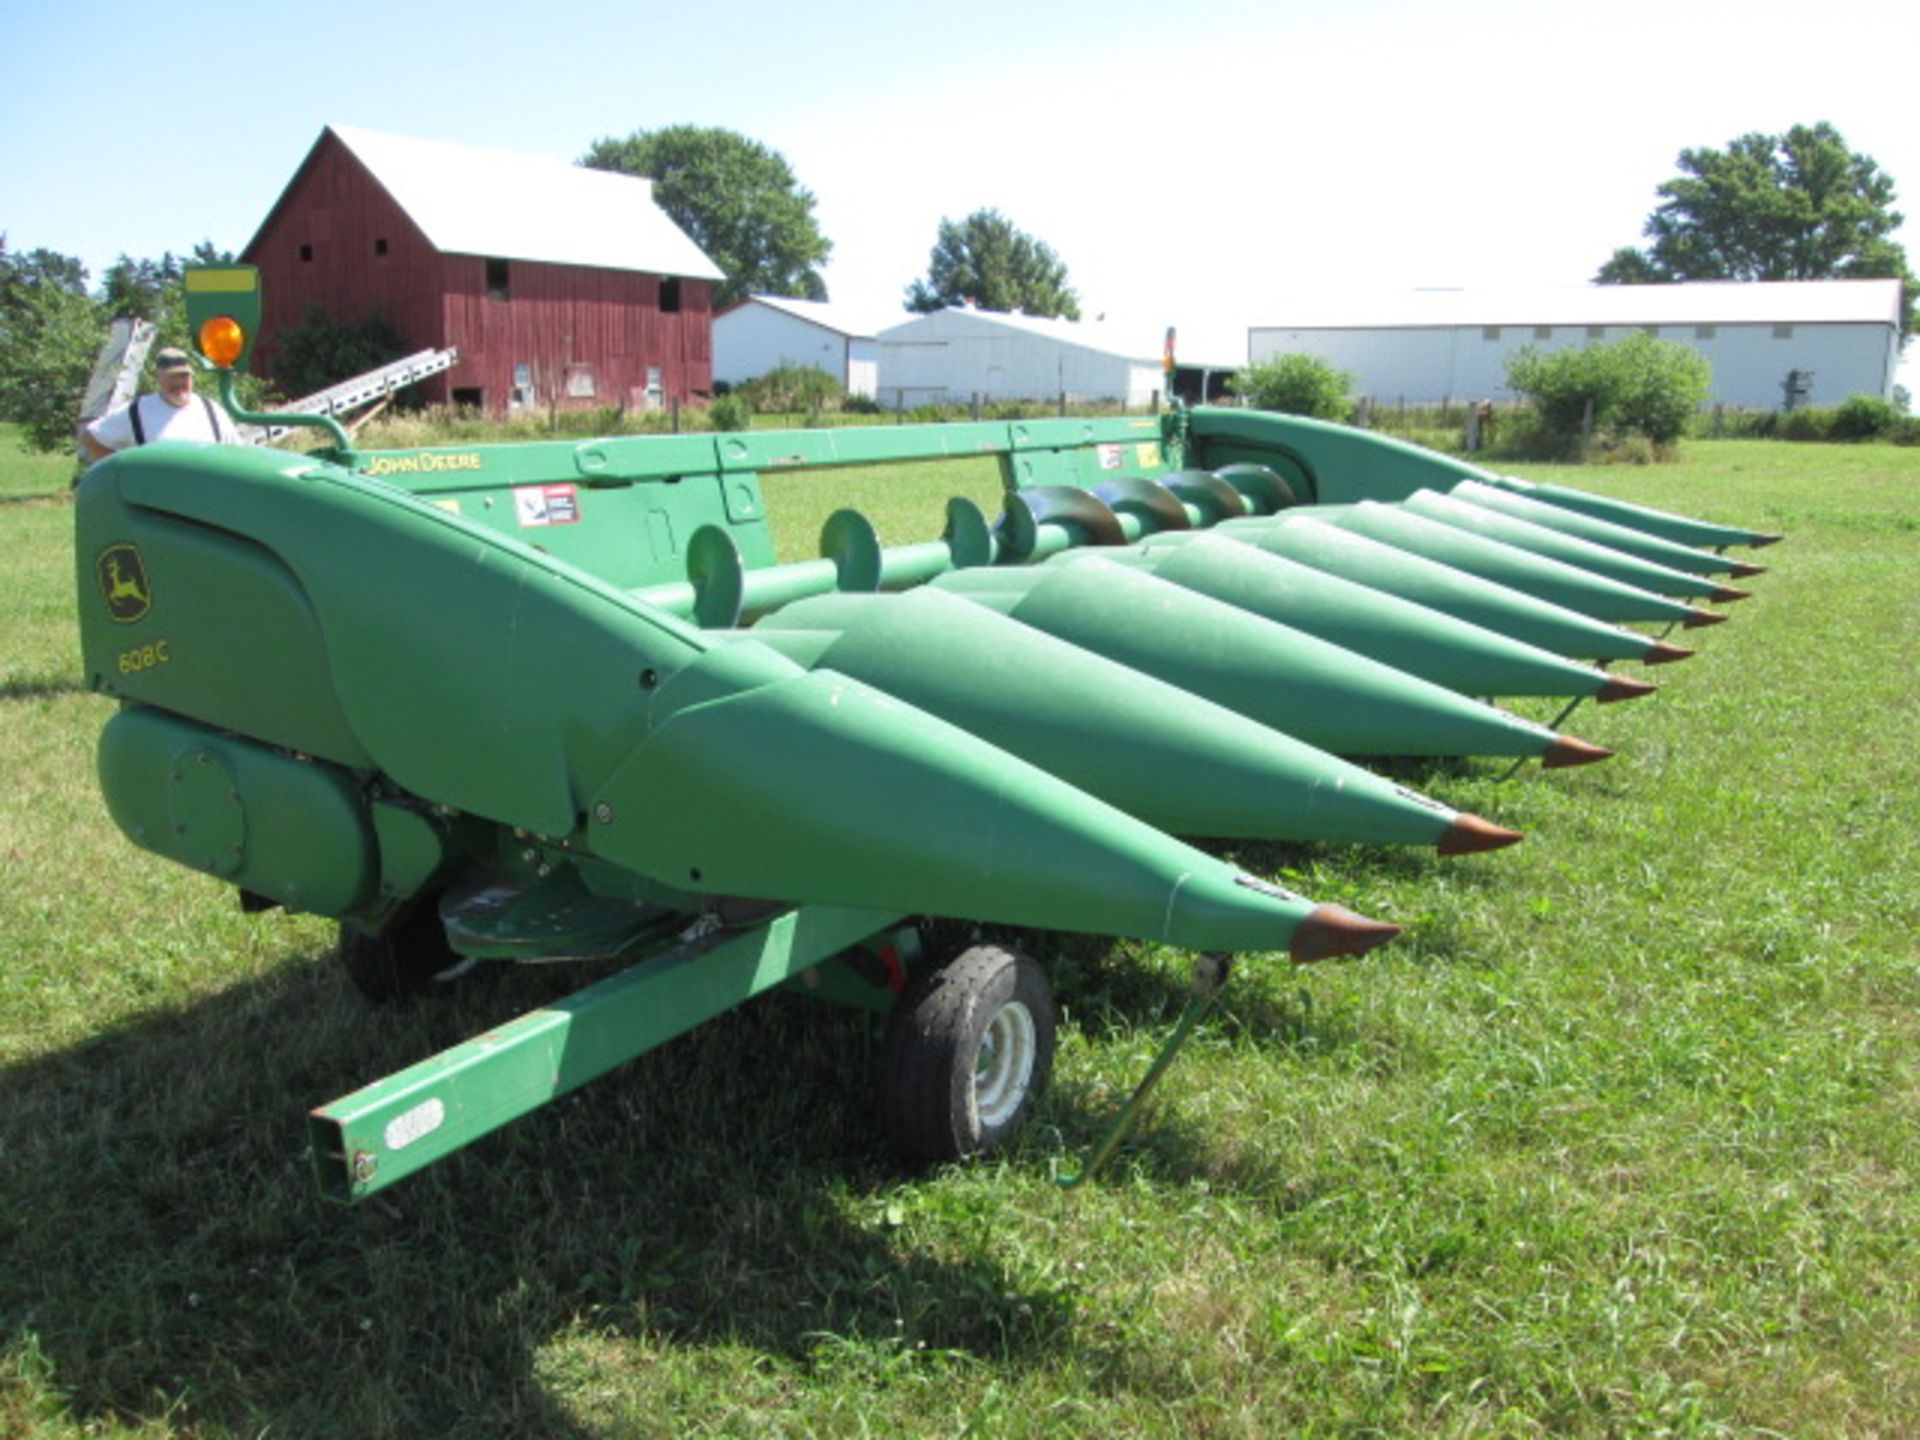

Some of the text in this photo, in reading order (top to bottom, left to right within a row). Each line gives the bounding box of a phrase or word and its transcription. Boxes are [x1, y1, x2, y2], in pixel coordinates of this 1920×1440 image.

[368, 453, 481, 475] JOHN DEERE
[118, 640, 169, 673] 608C
